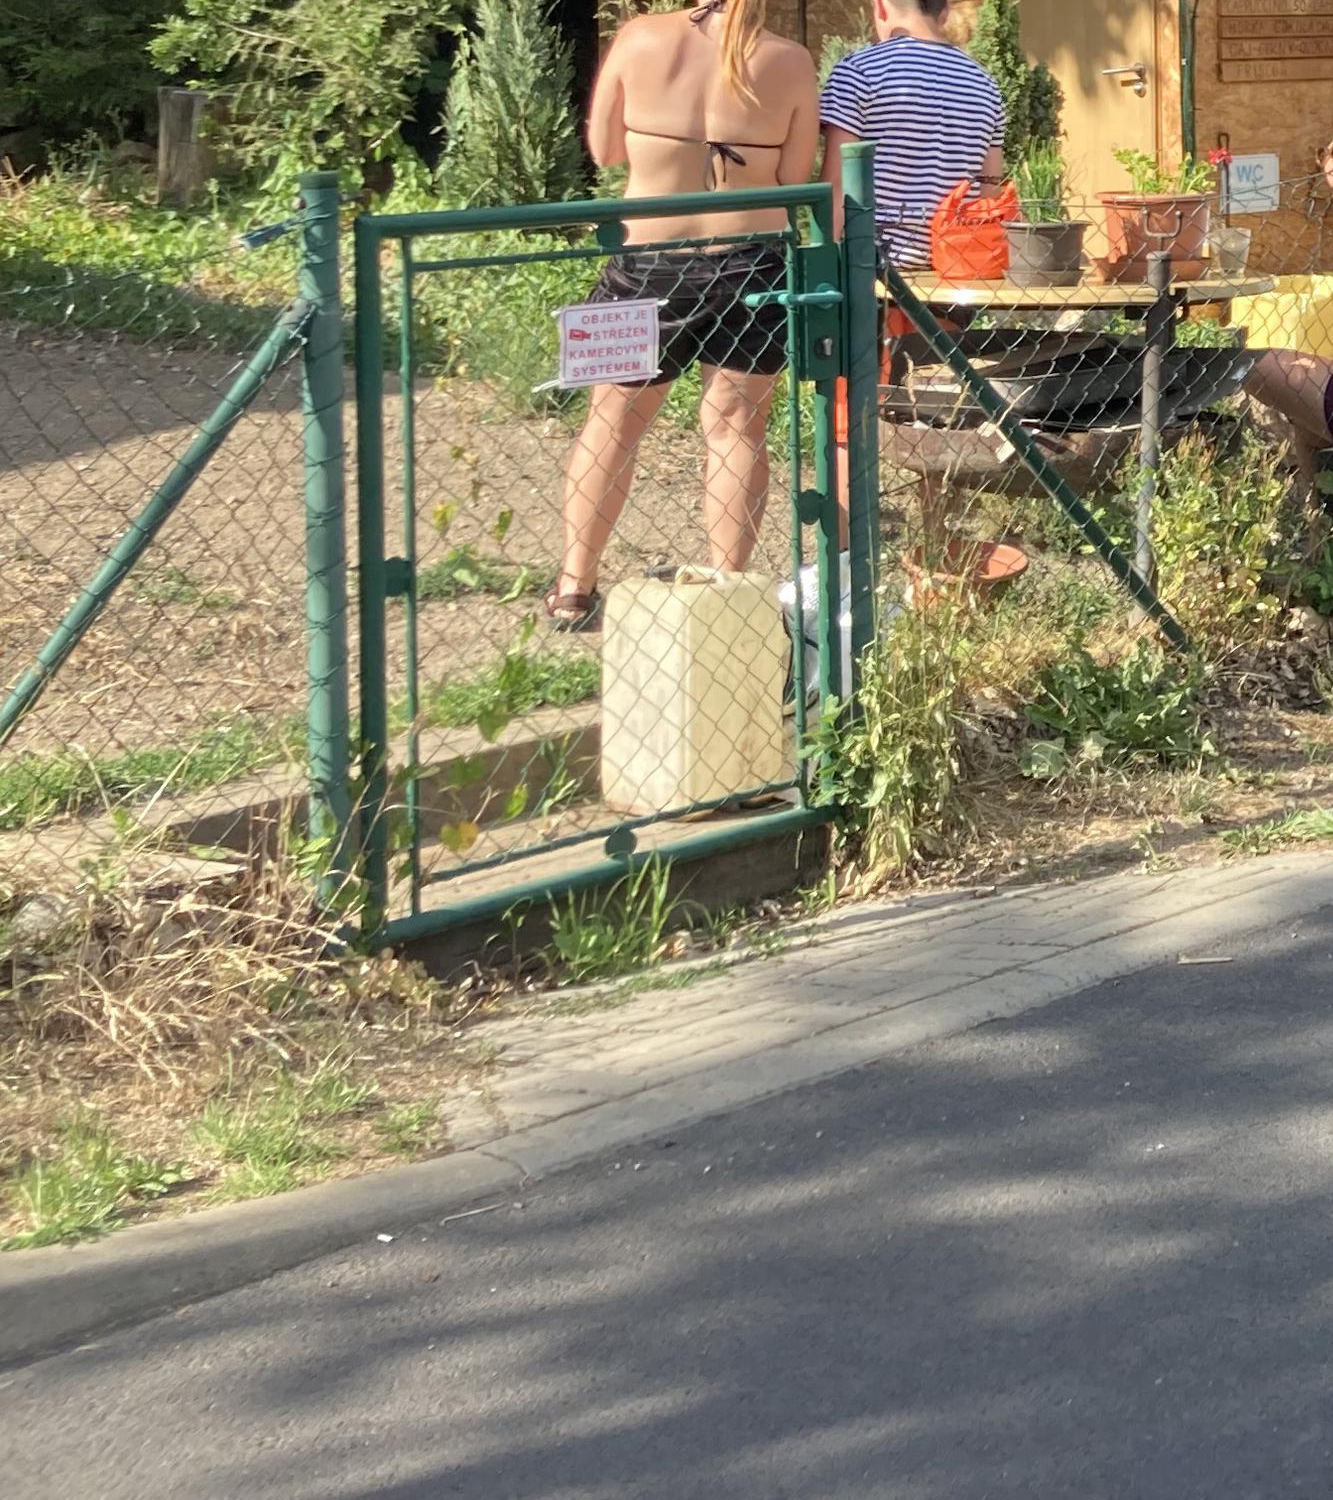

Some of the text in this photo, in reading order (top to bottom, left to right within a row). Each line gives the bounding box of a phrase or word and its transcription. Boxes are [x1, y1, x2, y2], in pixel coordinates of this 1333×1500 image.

[1236, 164, 1264, 182] WC
[581, 309, 648, 325] OBJEKT JE
[593, 326, 648, 341] STŘEŽEN
